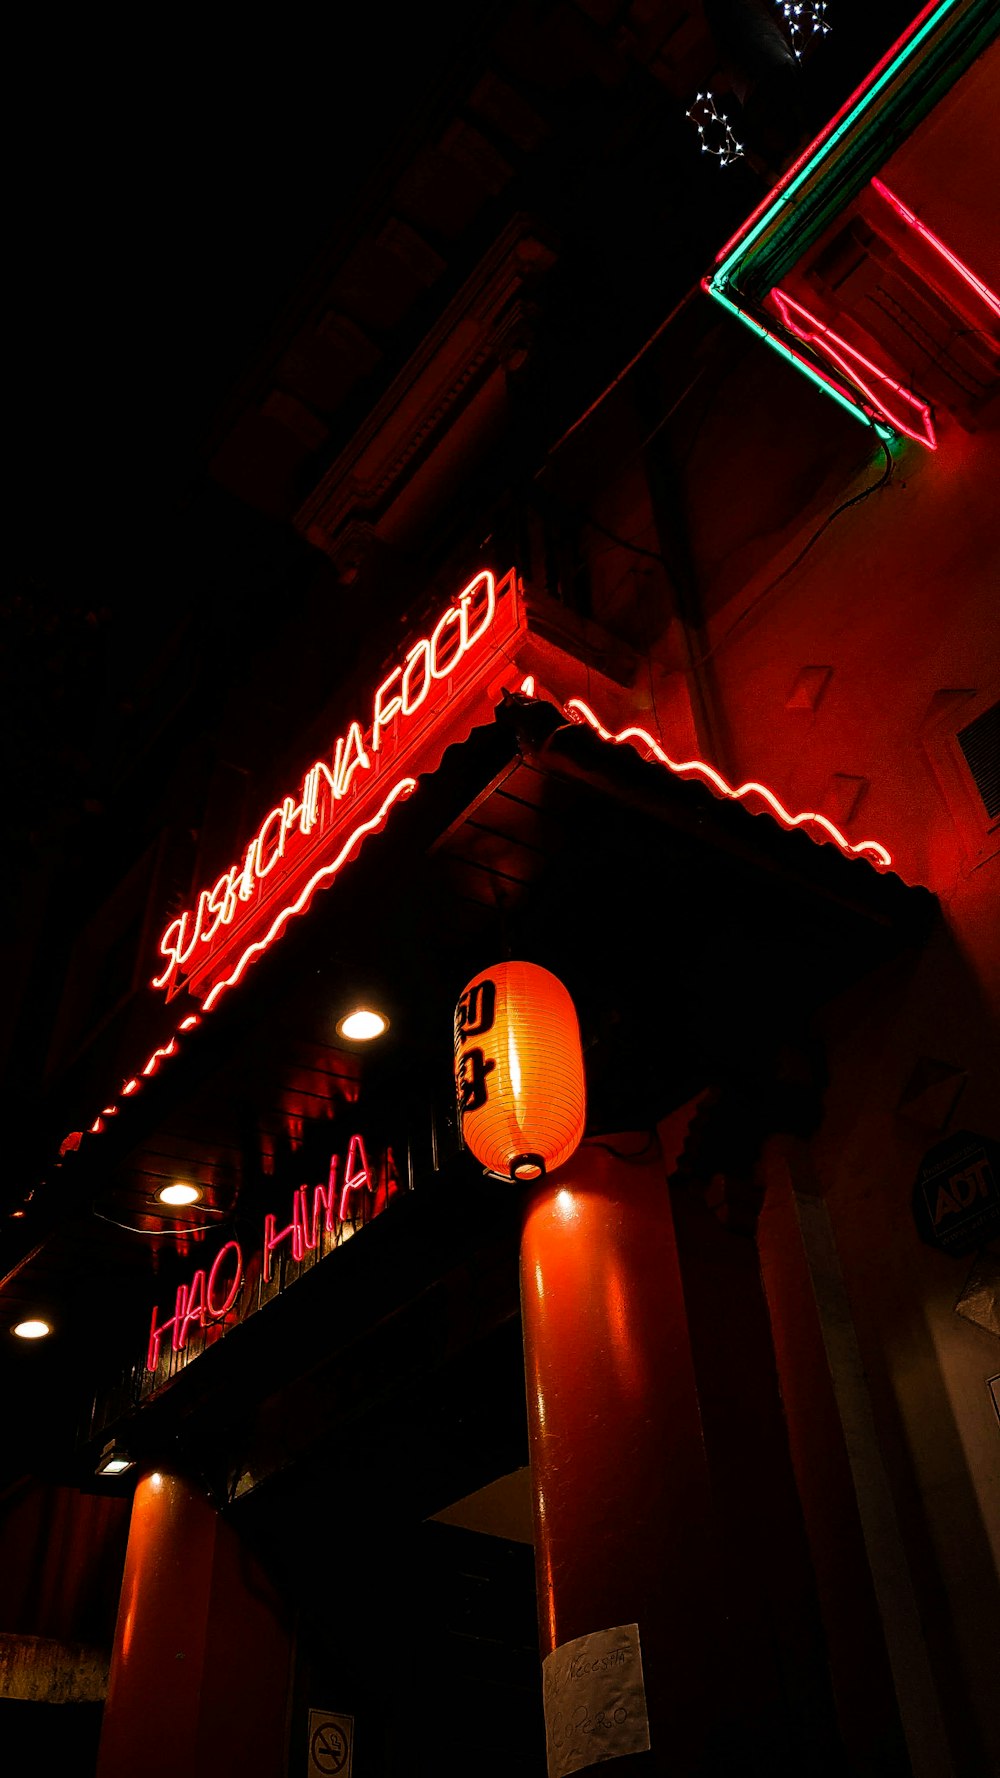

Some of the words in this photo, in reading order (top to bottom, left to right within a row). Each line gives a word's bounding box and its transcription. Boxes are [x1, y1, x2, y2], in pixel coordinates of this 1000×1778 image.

[152, 839, 258, 988] SUSHI
[254, 721, 371, 878] CHINA
[371, 569, 496, 752] FOOD
[933, 1157, 991, 1227] ADT
[146, 1240, 243, 1372] HAO
